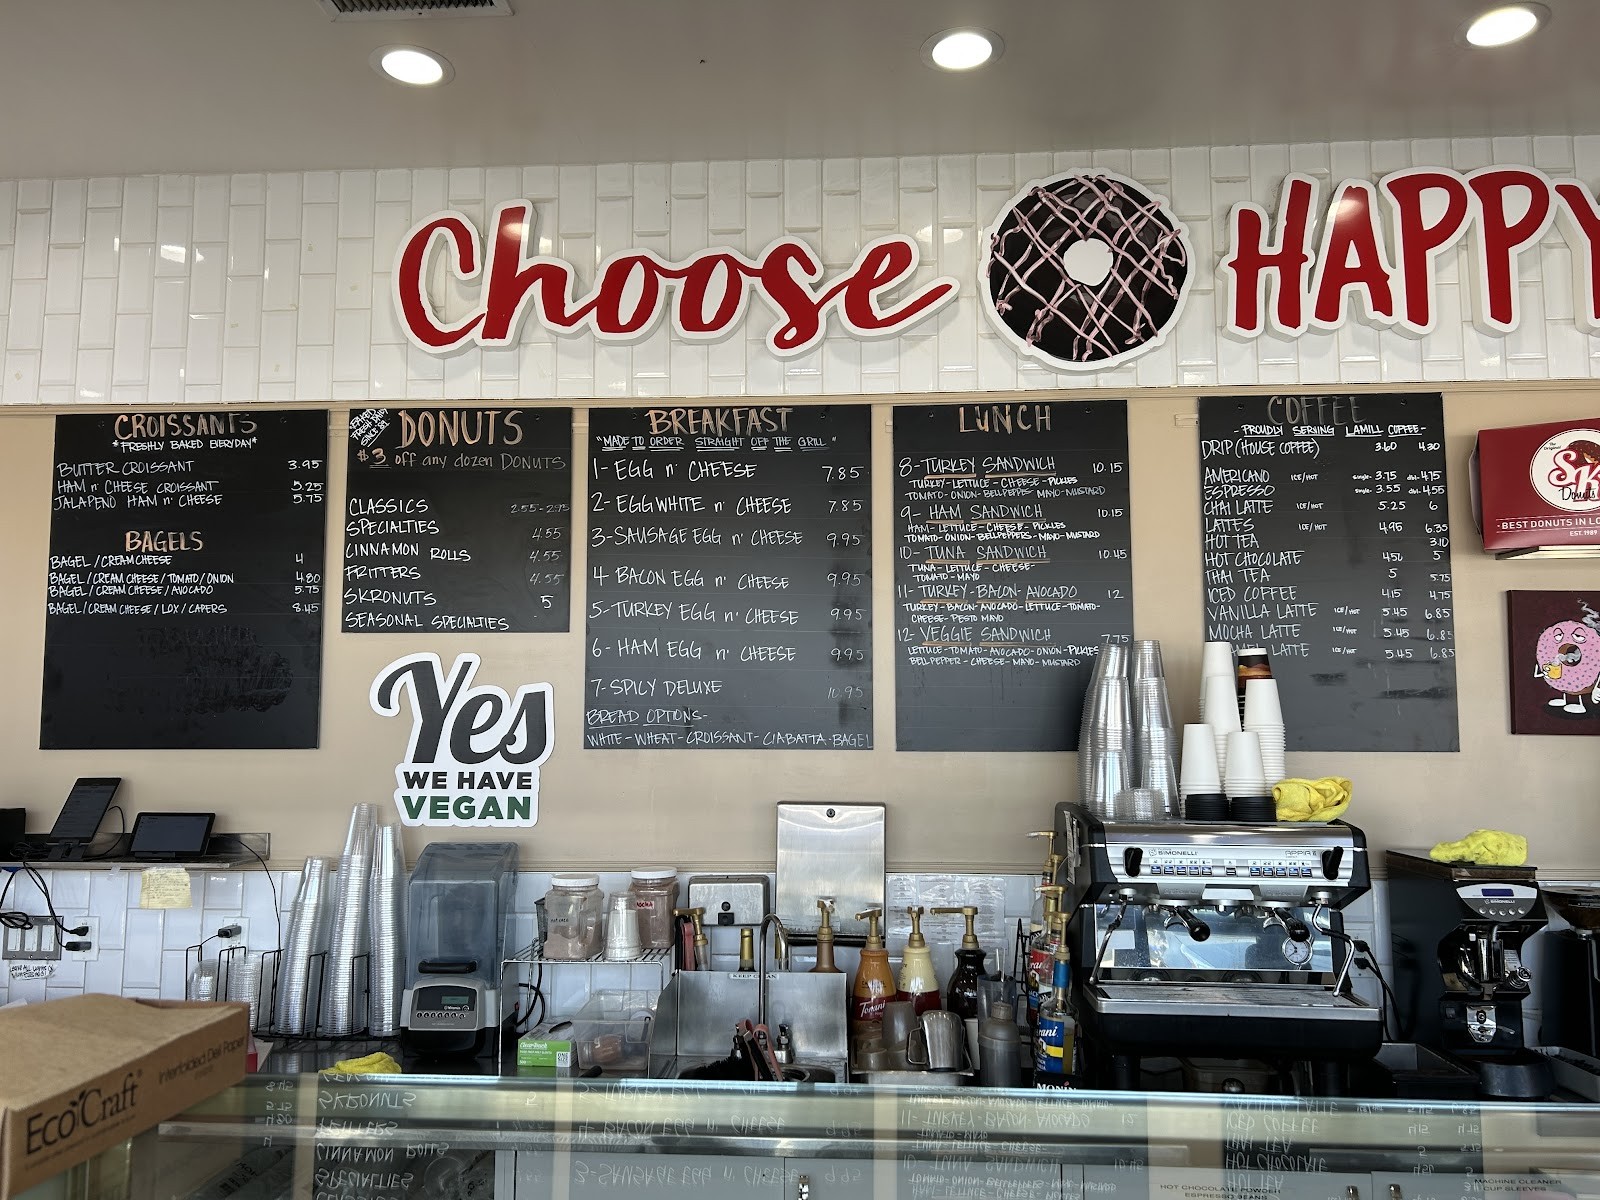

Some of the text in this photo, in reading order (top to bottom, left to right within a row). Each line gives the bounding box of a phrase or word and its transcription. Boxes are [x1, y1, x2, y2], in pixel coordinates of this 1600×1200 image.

[397, 204, 954, 350] Choose
[958, 403, 1050, 434] LUNCH
[1266, 396, 1367, 426] COFFEE
[114, 412, 257, 441] CROISSANTS
[398, 410, 523, 447] DONUTS
[644, 407, 792, 437] BREAKFAST
[1292, 424, 1384, 435] SERVING LAMILL
[170, 439, 203, 449] BAKED
[631, 436, 792, 446] TO ORDER STRAIGHT OFF THE
[1201, 440, 1233, 460] DRIP
[1375, 442, 1397, 451] 3.60
[1419, 442, 1440, 451] 4.30
[57, 460, 322, 477] BUTTER CROISSANT 3.95
[395, 451, 566, 470] off any dozen DONUTS
[982, 457, 1123, 474] SANDWICH 10.15
[614, 459, 863, 482] EGG CHEESE 7.85
[1205, 467, 1397, 485] AMERICANO 3.75
[58, 480, 323, 494] HAM CHEESE CROISSANT 5.25
[1204, 484, 1400, 500] ESPRESSO 3.55
[1559, 486, 1597, 501] Donuts
[128, 496, 157, 508] HAM
[179, 494, 222, 507] CHEESE
[293, 494, 323, 503] 5.75
[350, 498, 428, 516] CLASSICS
[737, 496, 863, 515] CHEESE 7.85
[1204, 500, 1438, 515] CHAI LATTE 5.25 6
[930, 504, 1123, 520] HAM SANDWICH 10.15
[346, 518, 560, 539] SPECIALTIES 4.55
[1206, 518, 1254, 532] LATTES
[1501, 517, 1587, 530] BEST DONUTS IN
[126, 531, 203, 553] BAGELS
[692, 528, 862, 547] EGG CHEESE 9.95
[1205, 533, 1449, 550] HOT TEA 3.10
[346, 543, 418, 558] CINNAMON
[430, 548, 471, 561] ROLLS
[925, 545, 1127, 560] TUNA SANDWICH 10.45
[1205, 551, 1444, 567] HOT CHOCOLATE 5
[50, 553, 303, 569] BAGEL 4
[343, 564, 421, 581] FRITTERS
[615, 566, 862, 590] BACON EGG CHEESE 9.95
[1205, 568, 1452, 585] THAI TEA 5 5.75
[344, 588, 553, 608] SKRONUTS 5
[1108, 590, 1124, 599] 12
[1208, 586, 1297, 603] ICED COFFEE
[292, 603, 319, 614] 8.45
[679, 603, 866, 625] EGG CHEESE 9.95
[1207, 603, 1451, 621] VANILLA LATTE 5.45 6.85
[346, 612, 509, 630] SEASONAL SPECIALTIES
[950, 614, 1003, 623] PESTO MAYO
[920, 626, 1130, 644] VEGGIE SANDWICH 7.75
[1209, 624, 1453, 640] MOCHA LATTE 5.45 6.85
[618, 638, 863, 661] HAM EGG CHEESE 9.95
[1272, 643, 1309, 657] LATTE
[1385, 649, 1413, 659] 5.45
[1430, 647, 1456, 659] 6.85
[663, 680, 722, 695] DELUXE
[378, 661, 546, 764] Yes
[586, 709, 639, 724] BREAD
[403, 771, 533, 790] WE HAVE
[401, 795, 531, 820] VEGAN
[1181, 1185, 1238, 1193] CHOCOLATE
